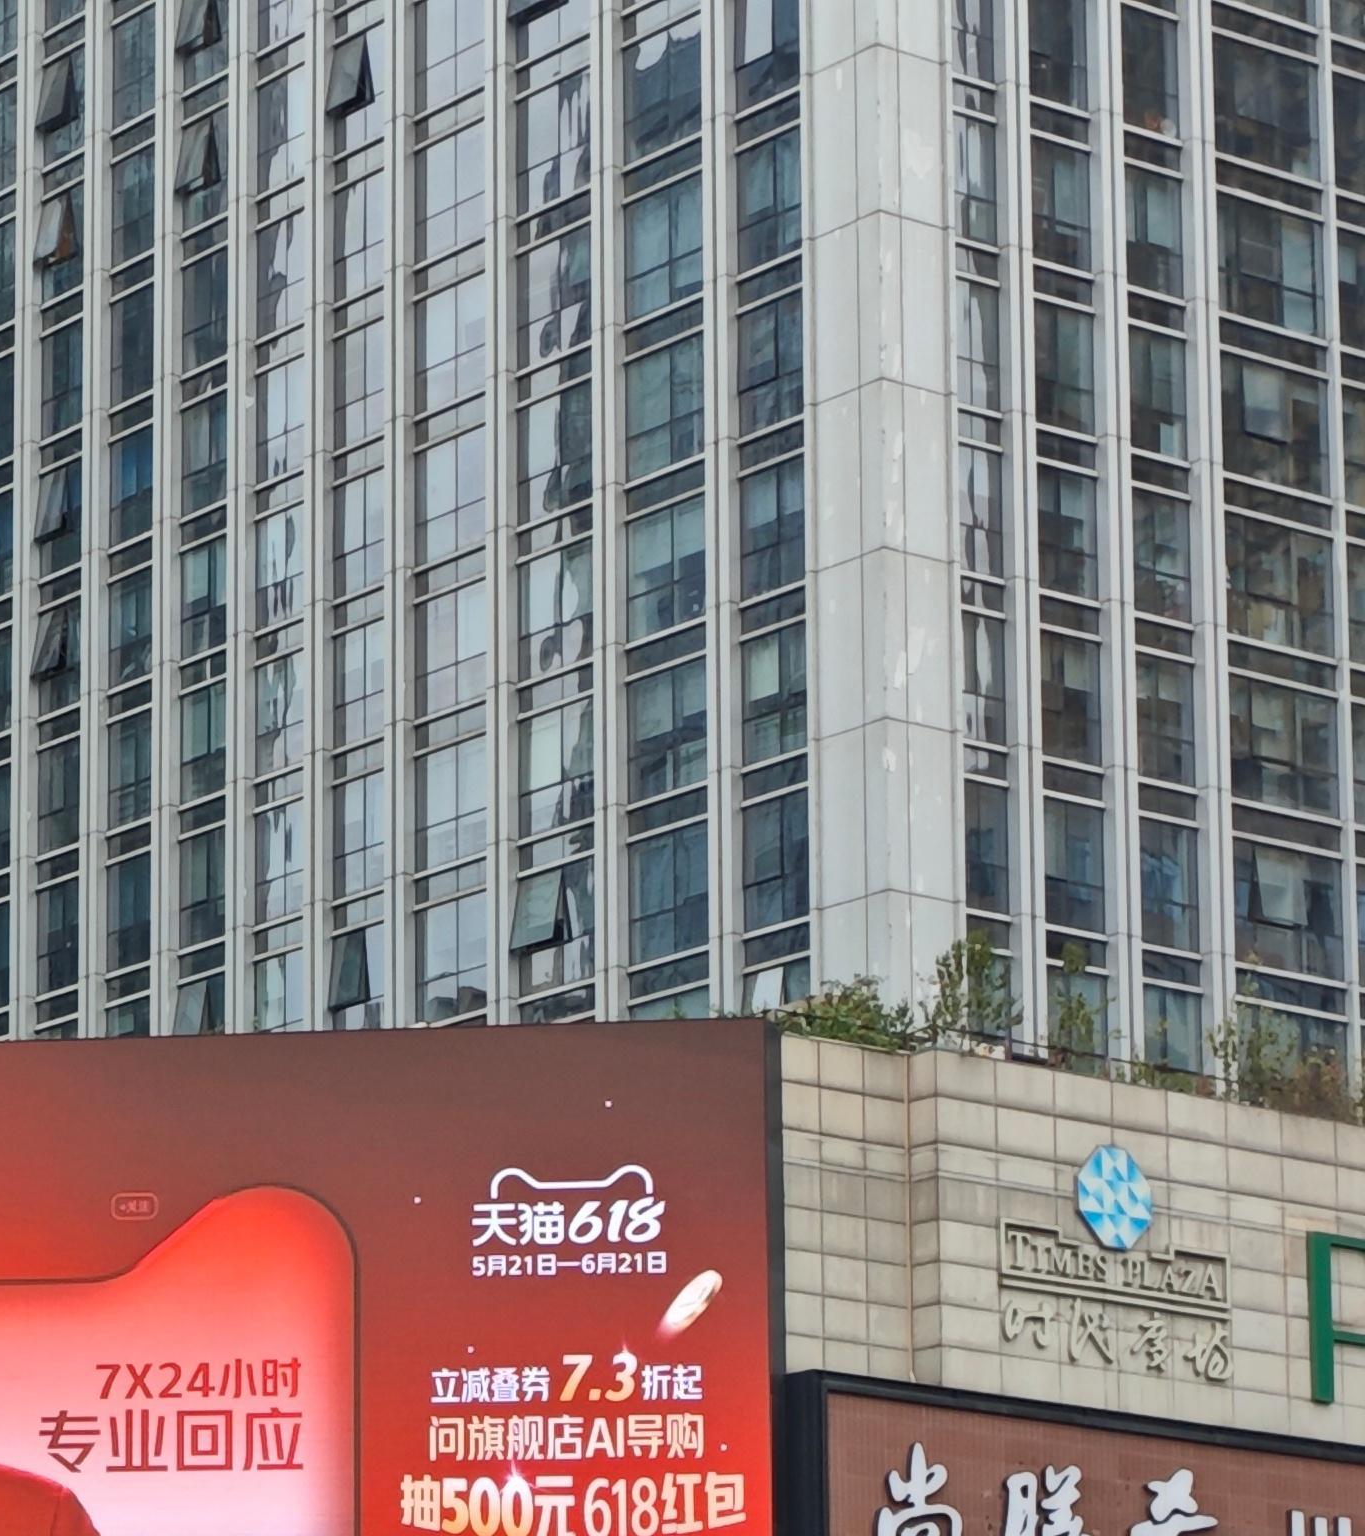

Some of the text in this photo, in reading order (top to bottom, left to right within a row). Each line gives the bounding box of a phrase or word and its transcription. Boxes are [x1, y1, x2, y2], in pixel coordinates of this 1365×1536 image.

[471, 1195, 666, 1248] 天猫618
[1007, 1230, 1223, 1300] TIMES PLAZA
[95, 1357, 302, 1400] 7X24小时
[39, 1407, 304, 1474] 专业回应
[428, 1413, 705, 1462] 问旗舰店AI导购
